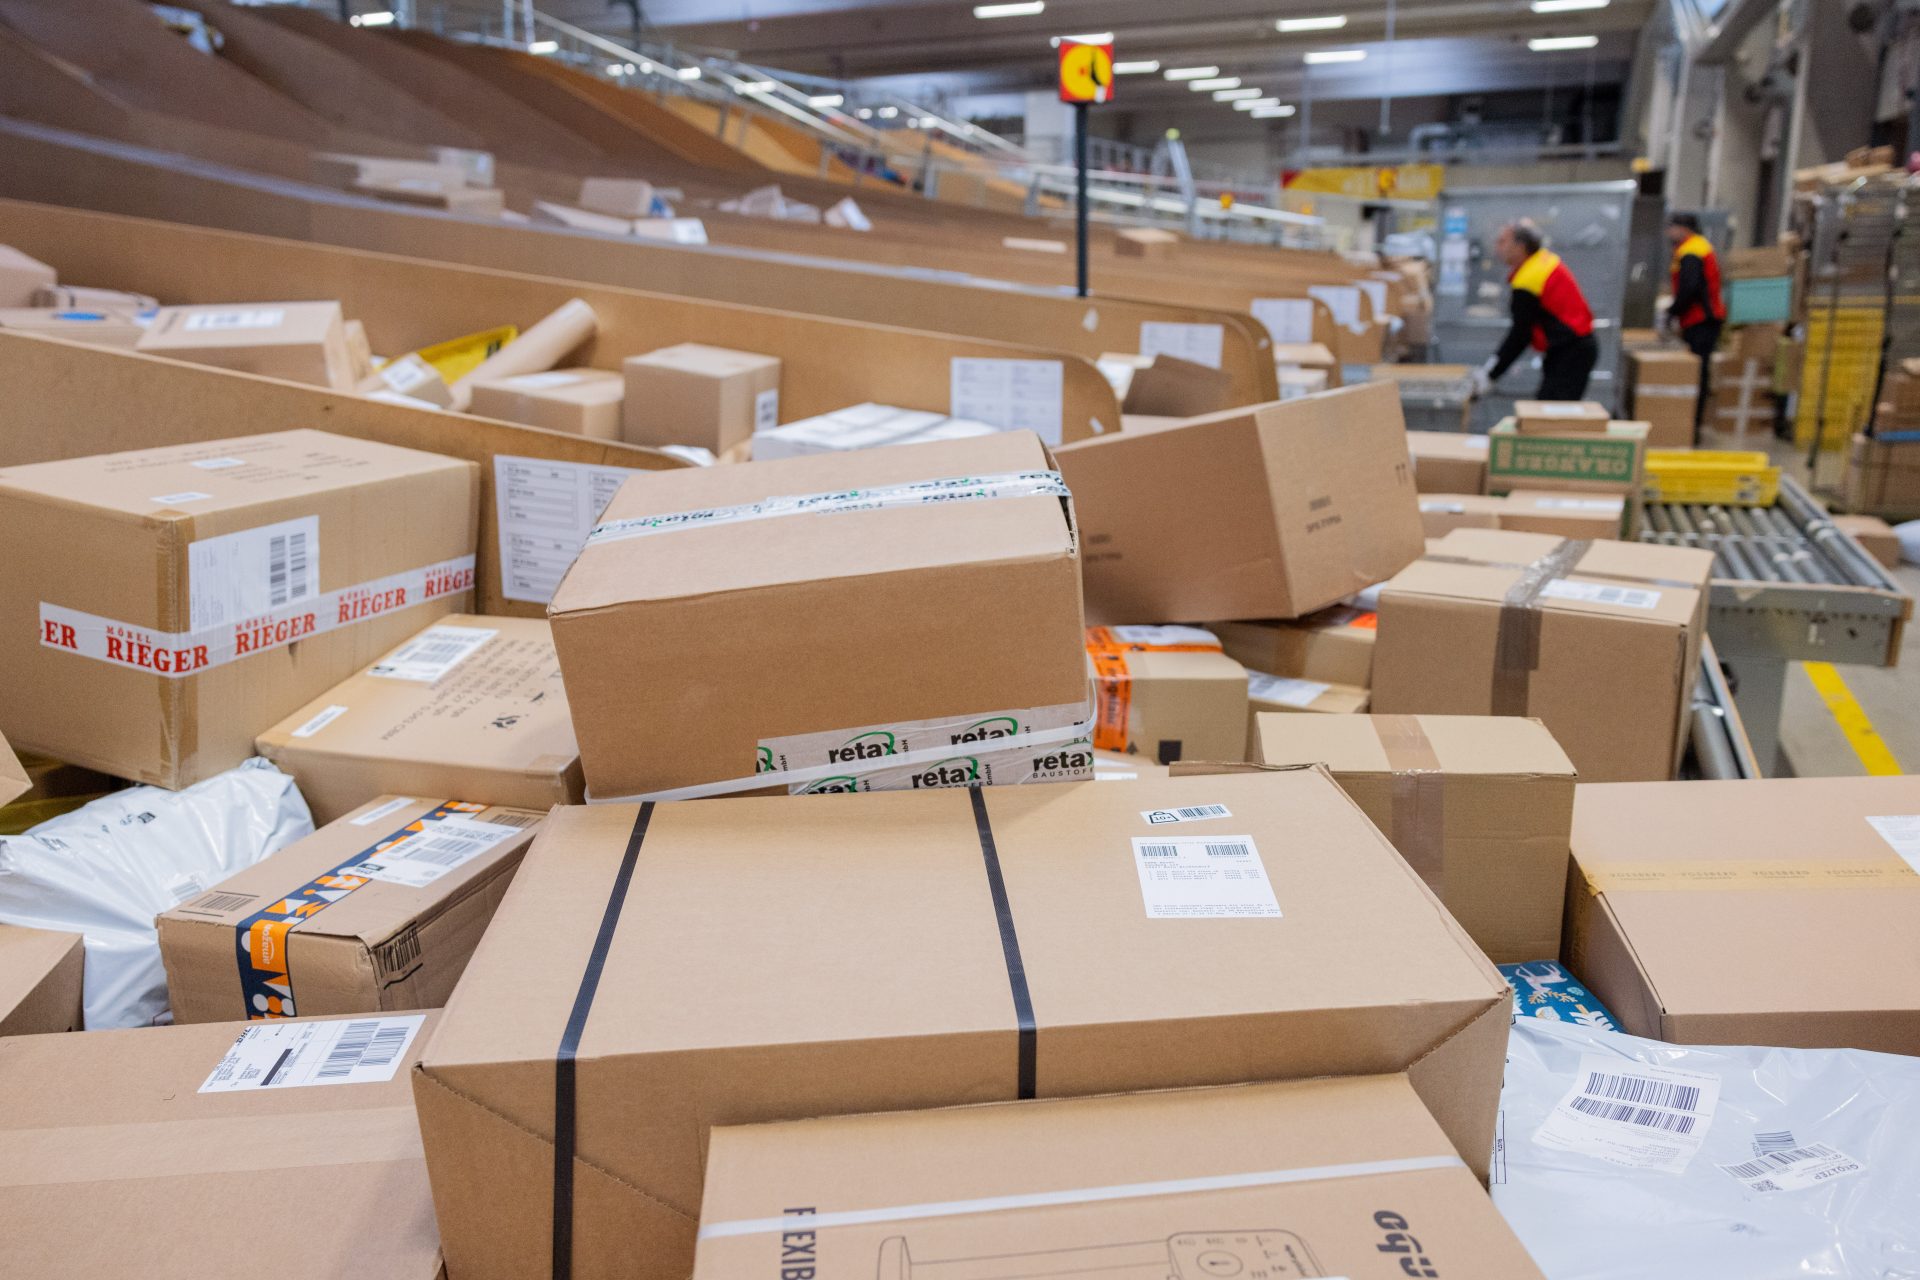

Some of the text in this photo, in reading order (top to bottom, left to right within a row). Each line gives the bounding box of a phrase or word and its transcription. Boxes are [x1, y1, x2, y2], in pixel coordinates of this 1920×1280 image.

[338, 587, 406, 624] RIEGER
[41, 619, 78, 650] ER
[106, 625, 152, 644] MÖBEL
[235, 612, 316, 656] RIEGER
[236, 614, 273, 632] MÖBEL
[106, 635, 209, 673] RIEGER
[828, 736, 898, 764] retax
[912, 760, 981, 789] retax
[985, 764, 993, 786] GmbH
[781, 1207, 816, 1280] FEXIB
